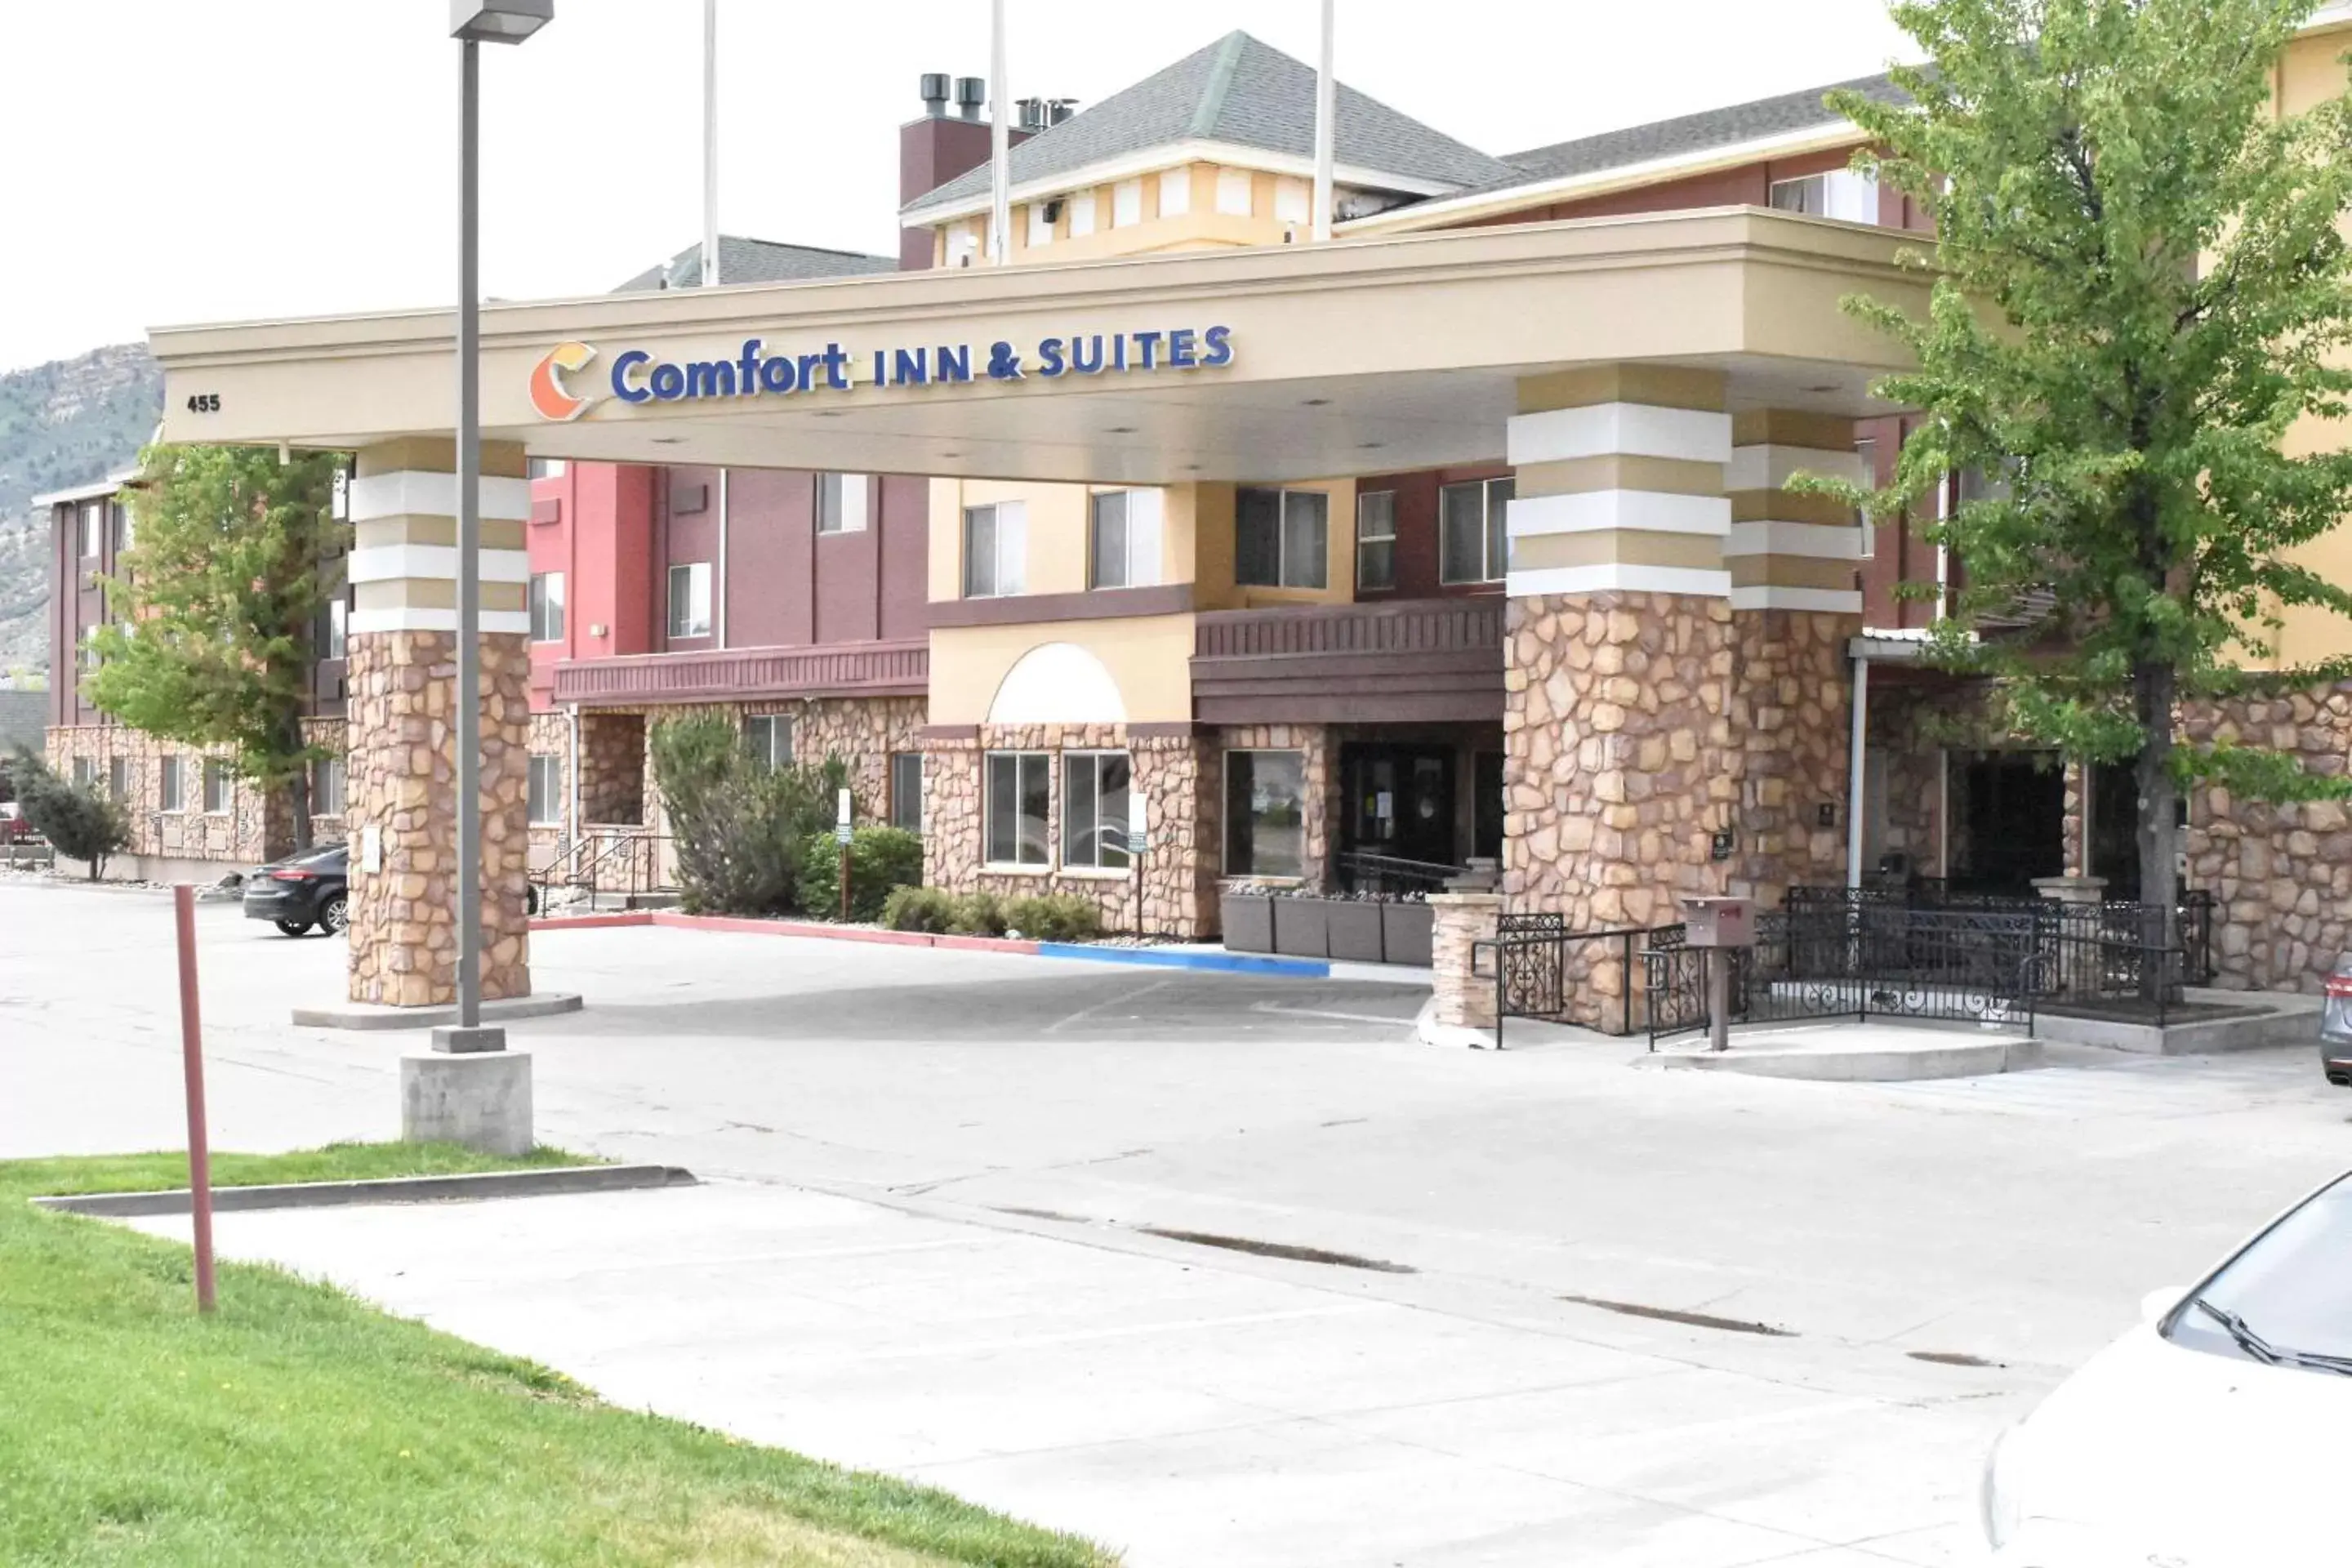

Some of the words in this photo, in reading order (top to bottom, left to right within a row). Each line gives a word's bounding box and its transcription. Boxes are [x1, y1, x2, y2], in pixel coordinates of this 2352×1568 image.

[611, 338, 850, 403] Comfort
[874, 345, 973, 386] INN
[987, 341, 1026, 380] &
[1039, 326, 1233, 376] SUITES
[188, 394, 220, 414] 455
